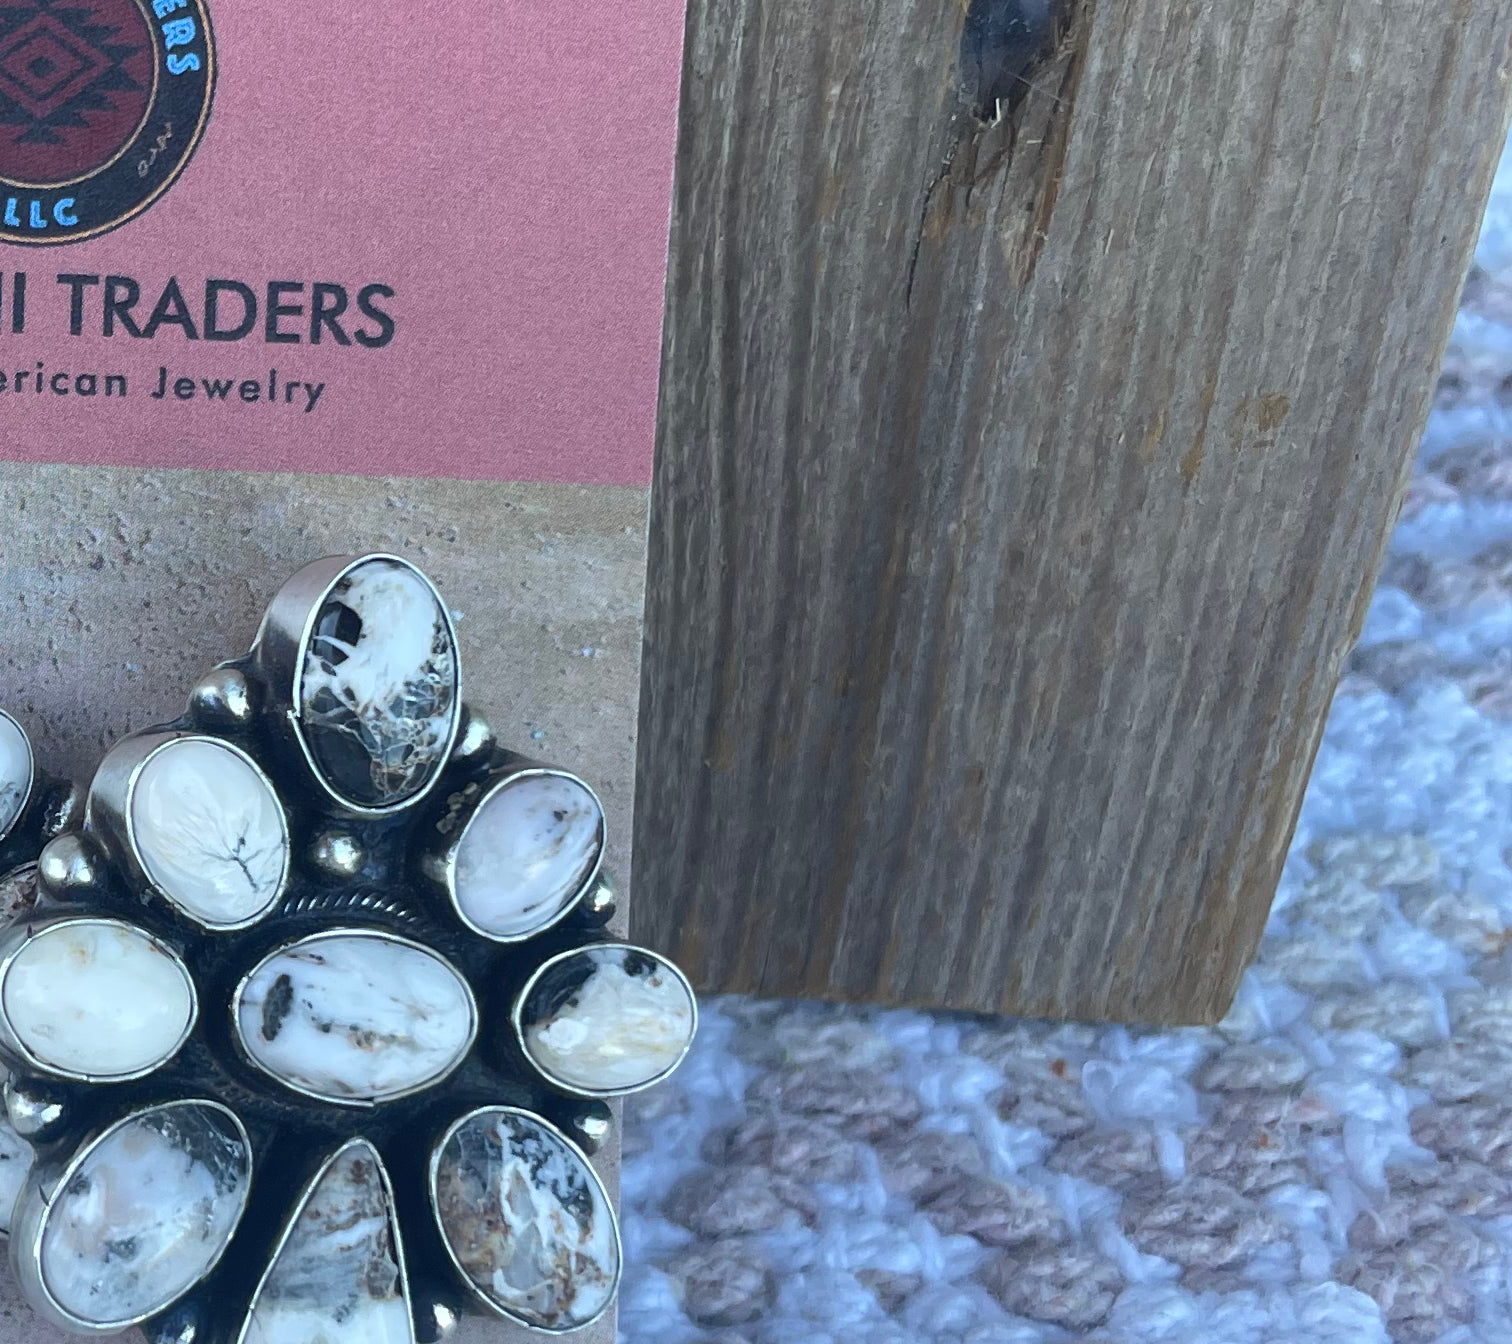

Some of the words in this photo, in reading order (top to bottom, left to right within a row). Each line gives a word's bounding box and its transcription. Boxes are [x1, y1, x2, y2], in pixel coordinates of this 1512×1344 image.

[3, 197, 79, 229] LLC
[56, 273, 397, 349] TRADERS
[150, 366, 327, 414] Jewelry
